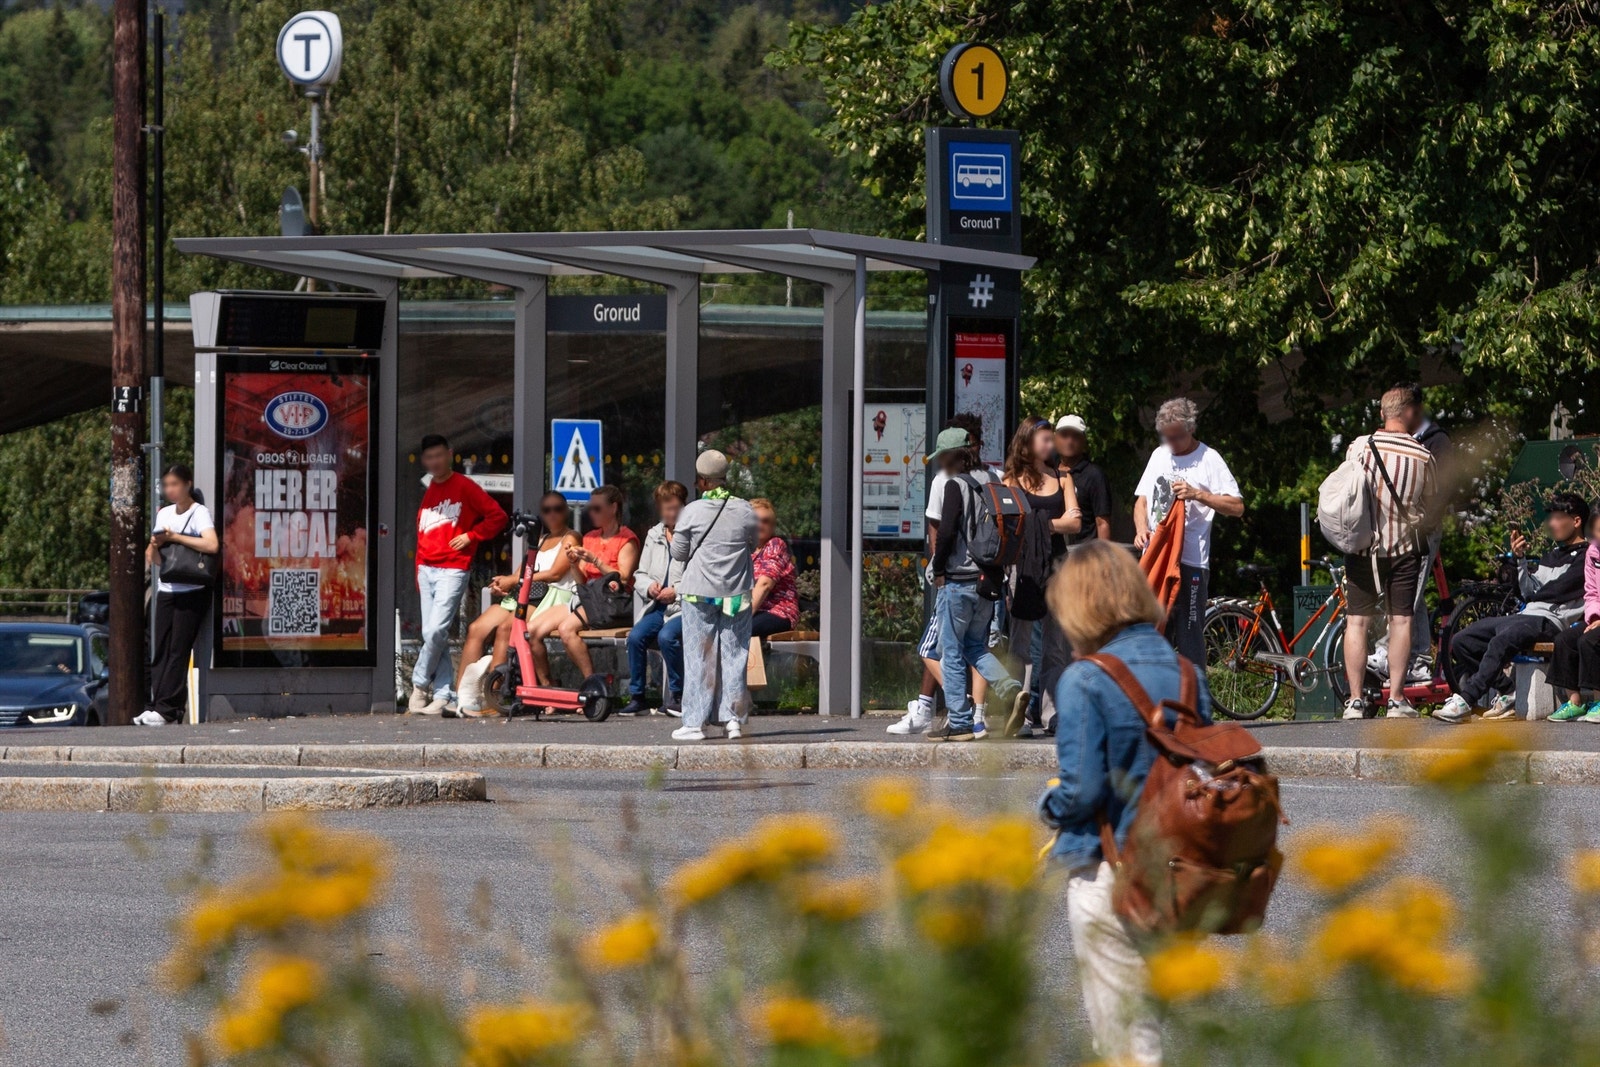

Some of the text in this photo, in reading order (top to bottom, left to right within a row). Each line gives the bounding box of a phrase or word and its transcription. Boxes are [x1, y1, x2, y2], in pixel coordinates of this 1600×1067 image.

[294, 34, 321, 71] T
[971, 62, 984, 100] 1
[960, 216, 1001, 229] Grorud T
[593, 303, 641, 322] Grorud
[280, 361, 327, 370] Clear Channel
[278, 394, 314, 404] STIFTET
[256, 453, 337, 464] OBOS LIGAEN
[255, 469, 338, 510] HER ER
[255, 511, 337, 558] ENGA!
